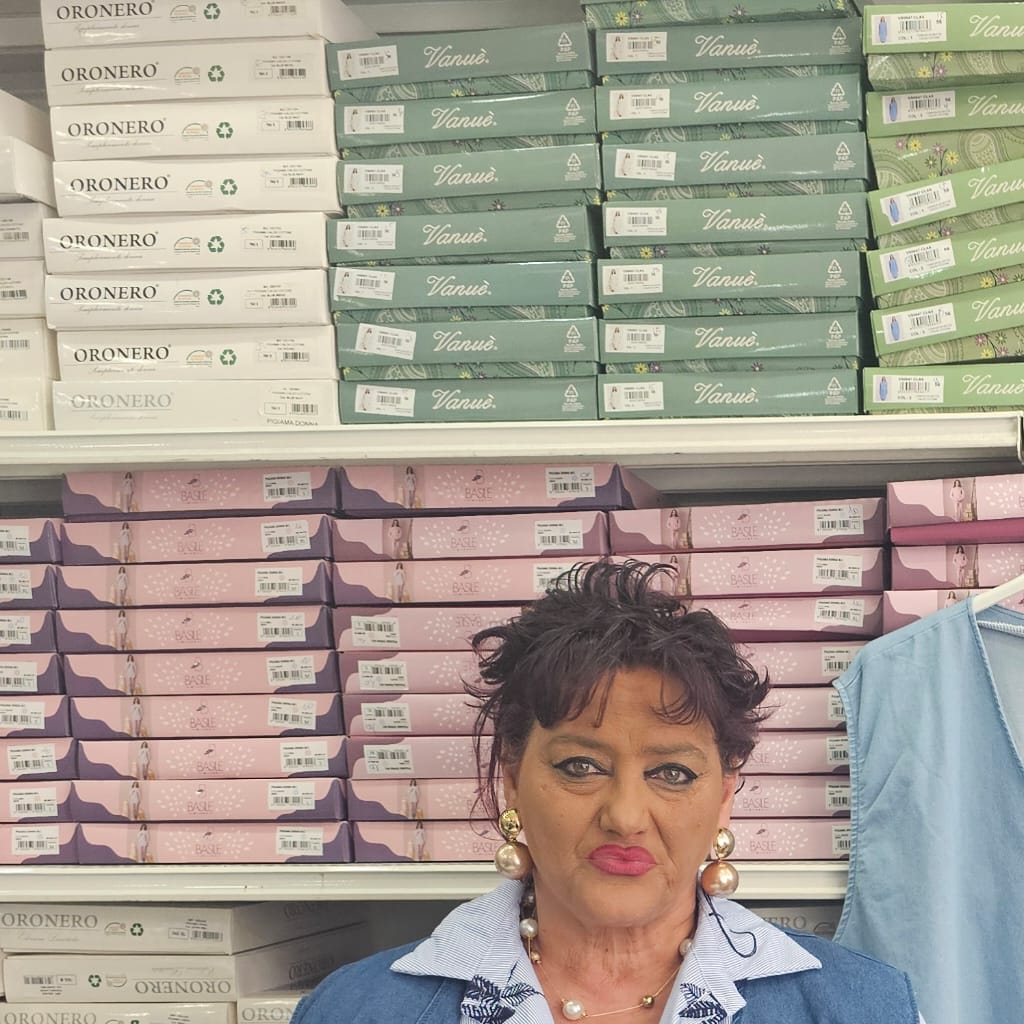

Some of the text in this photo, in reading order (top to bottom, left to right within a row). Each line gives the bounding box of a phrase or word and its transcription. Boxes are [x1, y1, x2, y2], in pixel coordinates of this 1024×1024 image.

[56, 1, 152, 20] ORONERO
[61, 63, 158, 82] ORONERO
[67, 119, 165, 138] ORONERO
[70, 176, 168, 192] ORONERO
[59, 233, 157, 250] ORONERO
[60, 285, 157, 301] ORONERO
[74, 346, 169, 363] ORONERO
[71, 393, 172, 409] ORONERO
[1, 913, 98, 929] ORONERO
[135, 980, 231, 994] ORONERO
